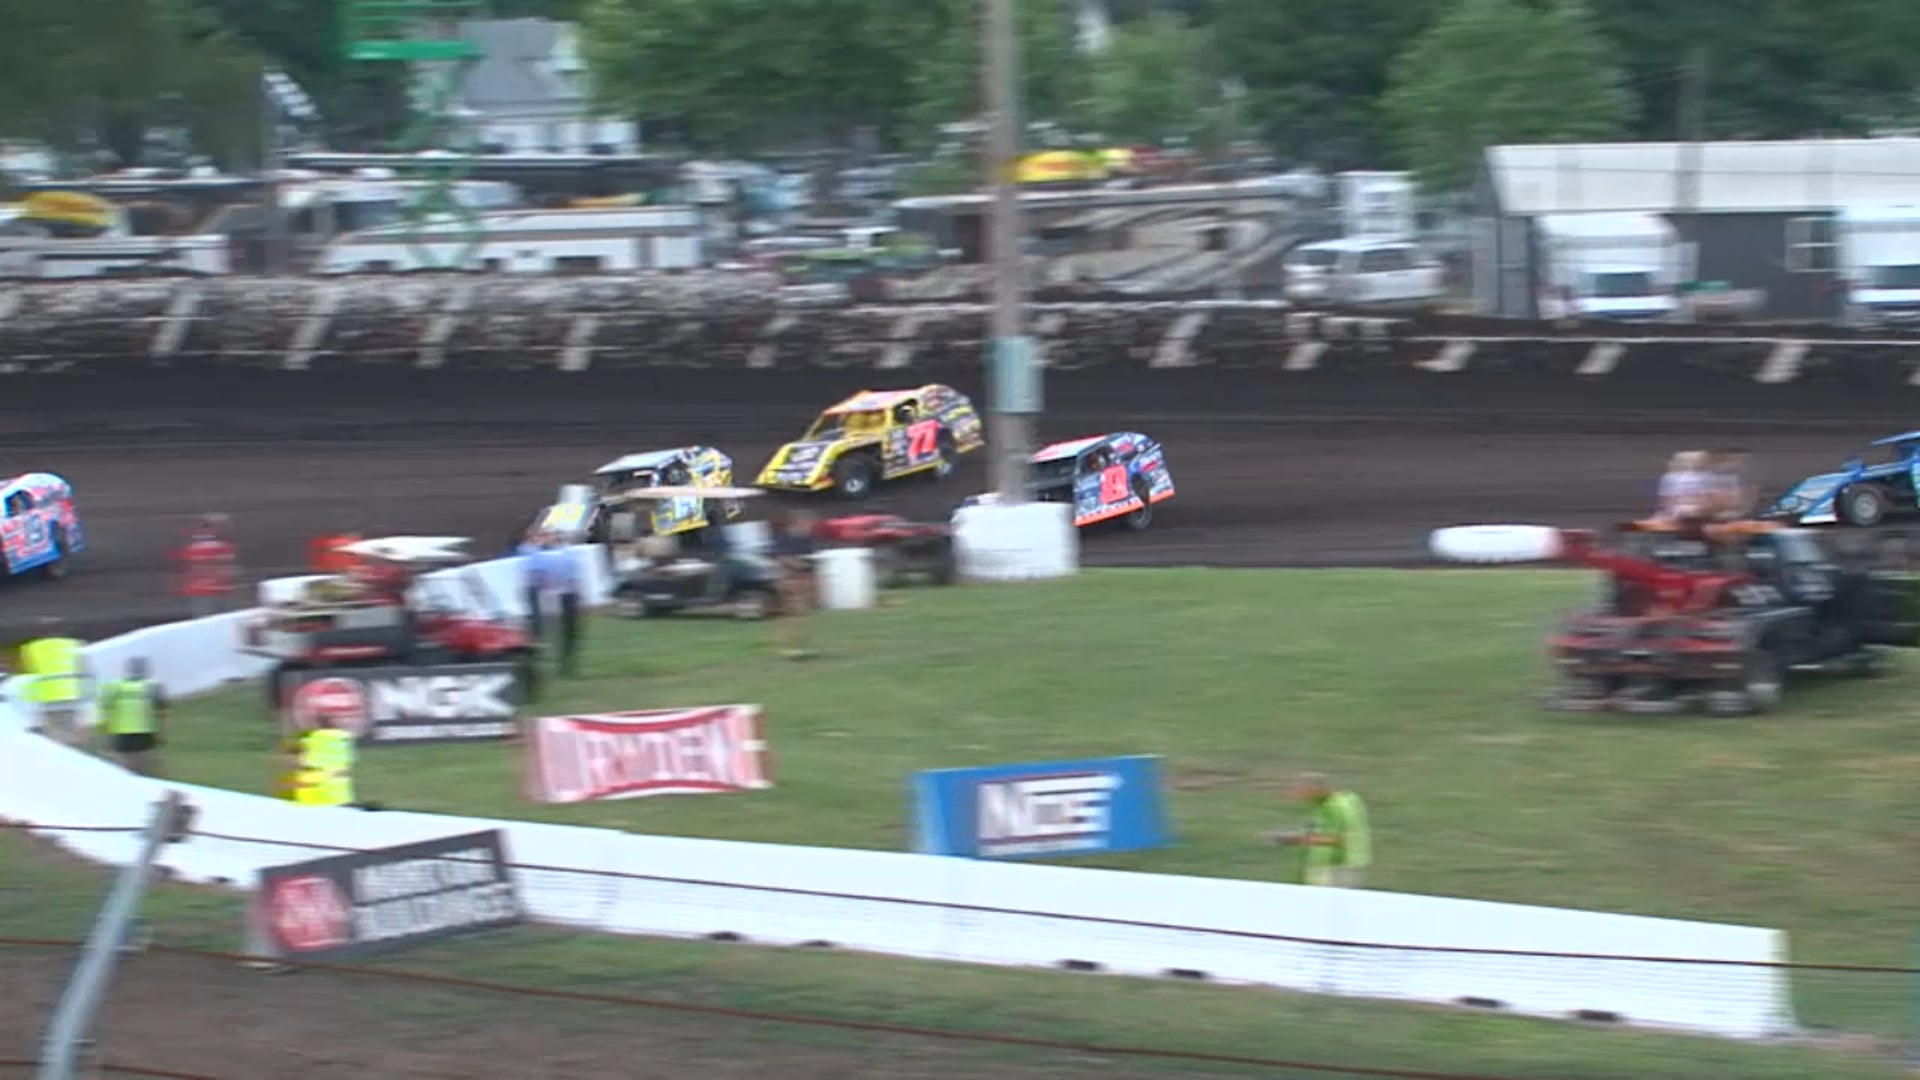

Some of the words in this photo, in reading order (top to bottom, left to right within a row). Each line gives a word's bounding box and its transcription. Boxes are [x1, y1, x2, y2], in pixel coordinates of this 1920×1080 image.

[907, 419, 938, 458] 77
[369, 671, 516, 722] NGK
[976, 772, 1122, 839] NOS
